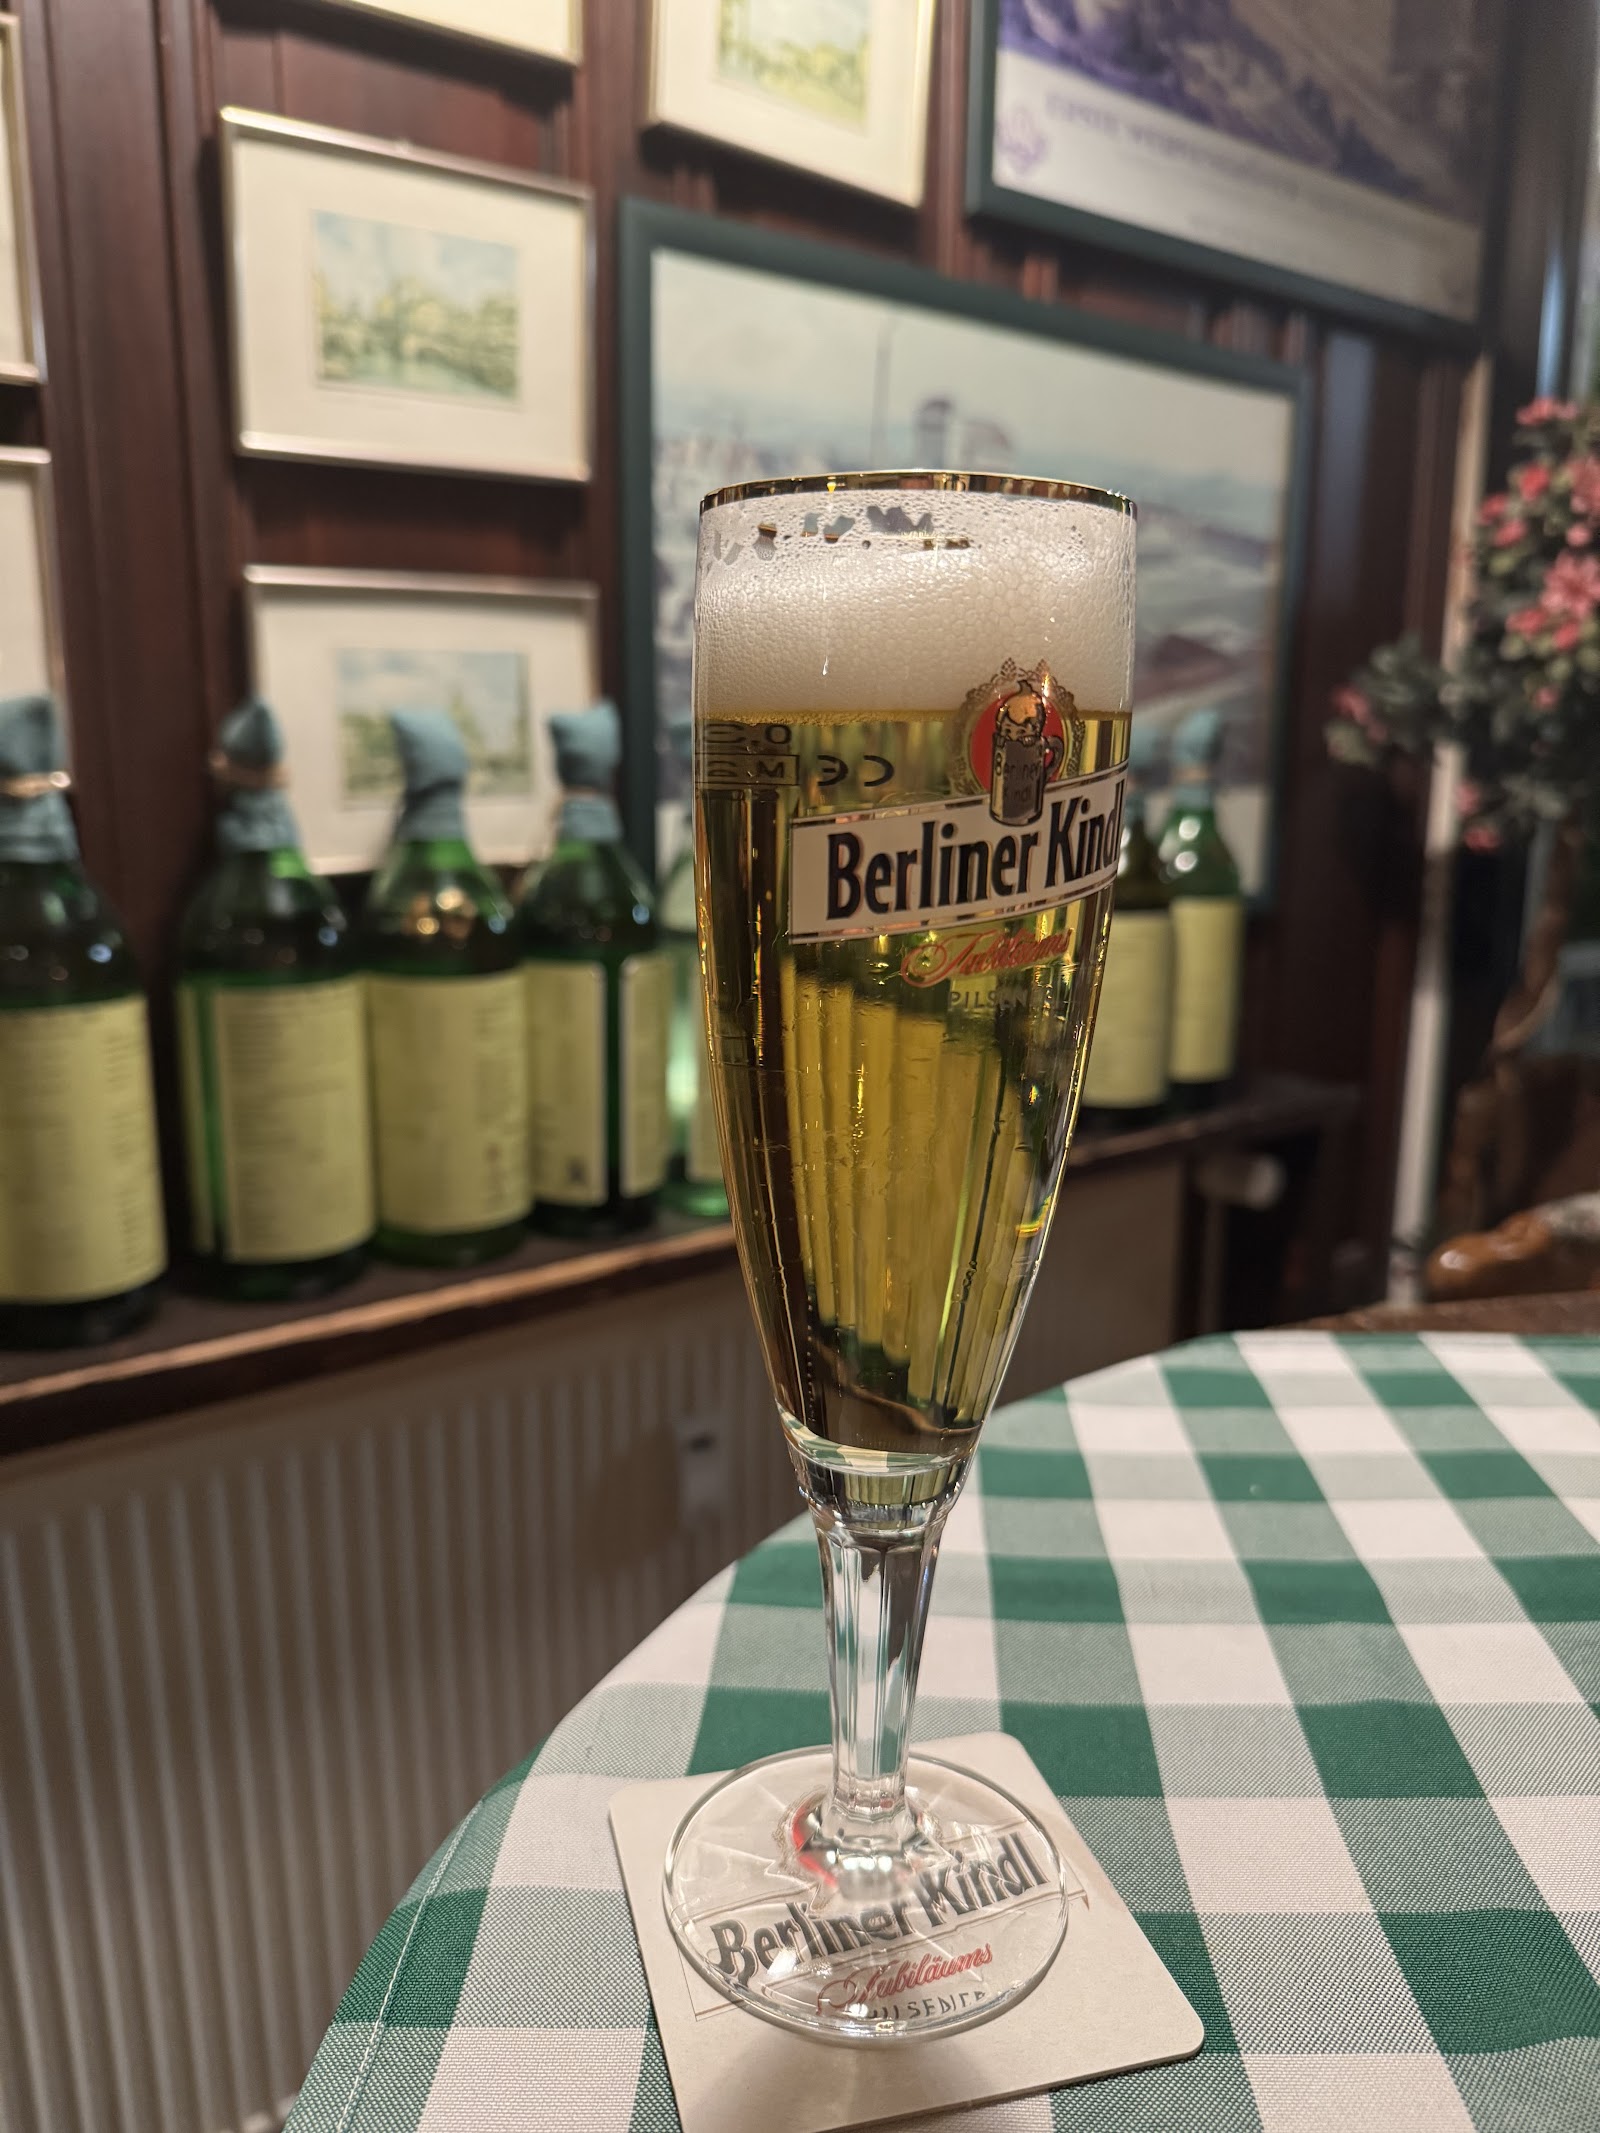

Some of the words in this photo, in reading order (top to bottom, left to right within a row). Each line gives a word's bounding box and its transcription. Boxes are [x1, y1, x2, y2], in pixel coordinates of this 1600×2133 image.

[827, 819, 1039, 920] Berliner
[1044, 778, 1125, 888] Kindl
[703, 1901, 915, 1990] Berliner
[918, 1831, 1050, 1927] Kindl
[817, 1943, 992, 2015] Jubiläums
